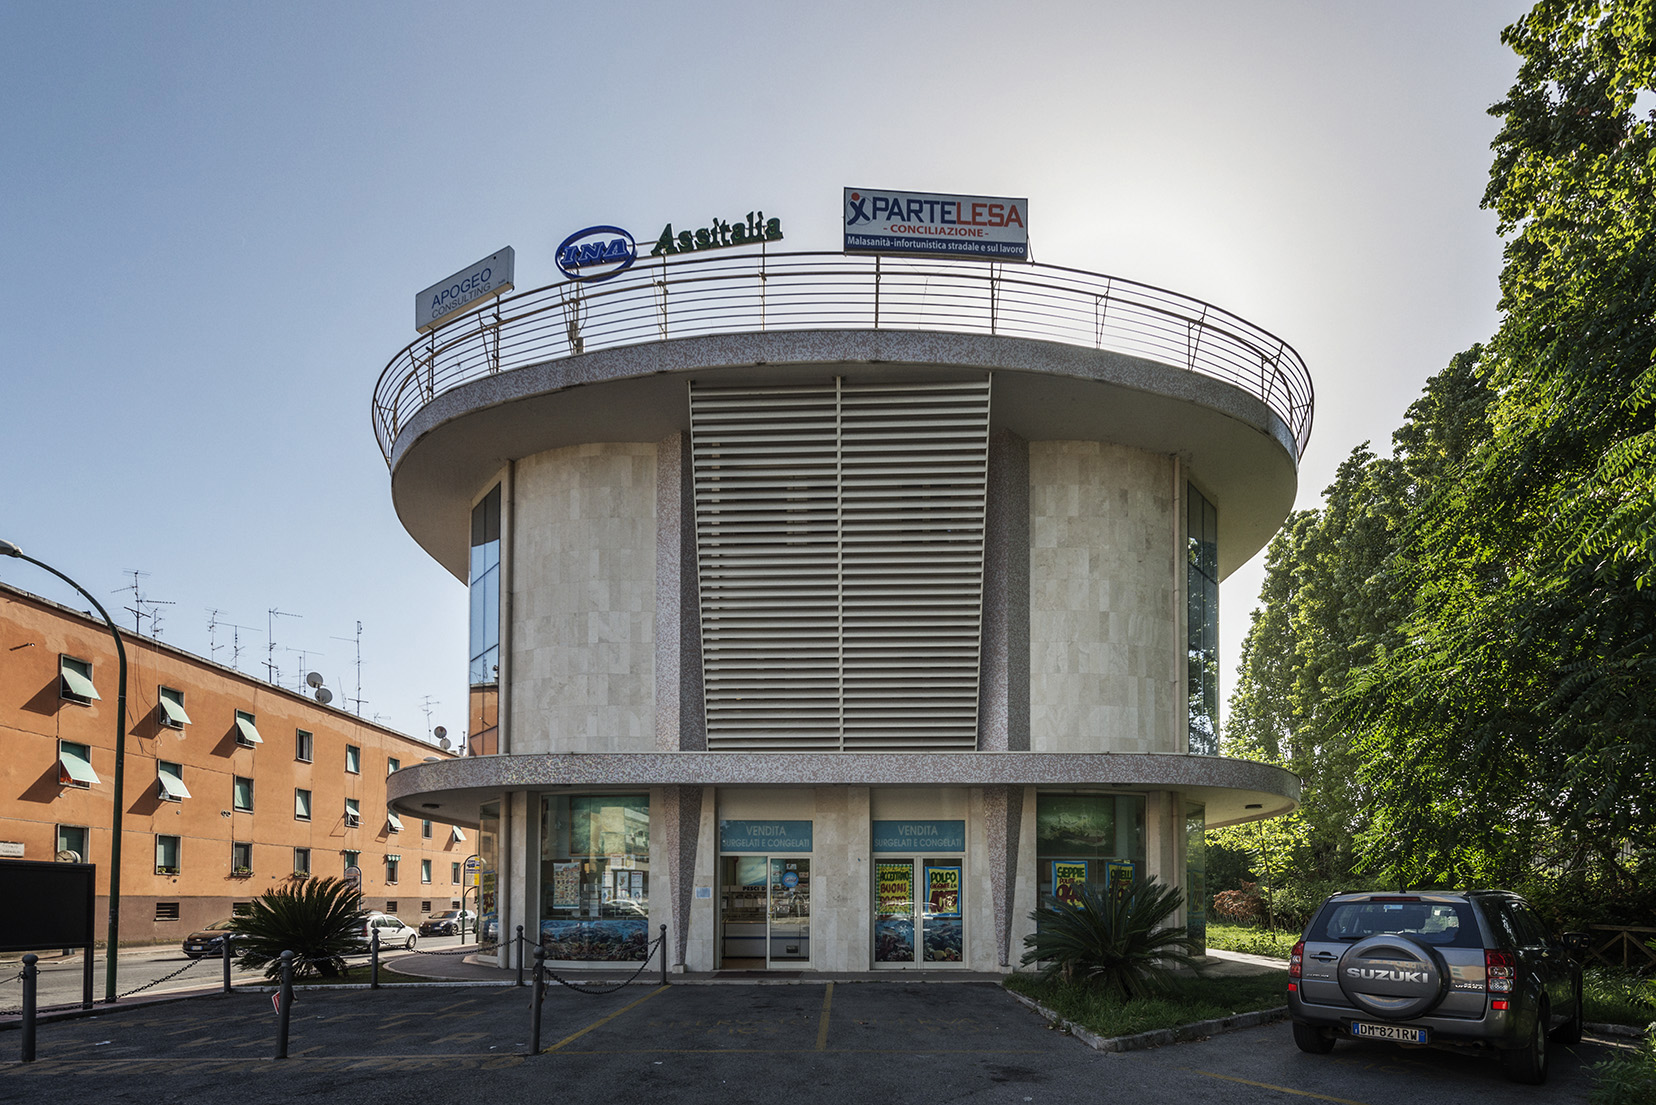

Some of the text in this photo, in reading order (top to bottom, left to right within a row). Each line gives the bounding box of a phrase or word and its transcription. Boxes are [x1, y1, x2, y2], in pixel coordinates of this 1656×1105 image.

[650, 210, 784, 257] Assitalia
[561, 238, 630, 270] INA
[948, 242, 979, 252] stradale
[987, 244, 999, 253] sul
[999, 245, 1024, 255] lavoro
[431, 267, 492, 310] APOGEO
[431, 282, 491, 319] CONSULTING
[746, 825, 787, 837] VENDITA
[897, 825, 939, 837] VENDITA
[722, 838, 810, 848] SURGELATI E CONGELATI
[874, 838, 962, 848] SURGELATI E CONGELATI
[930, 871, 957, 883] POLPO
[880, 882, 908, 894] BUONI
[1346, 967, 1429, 984] SUZUKI
